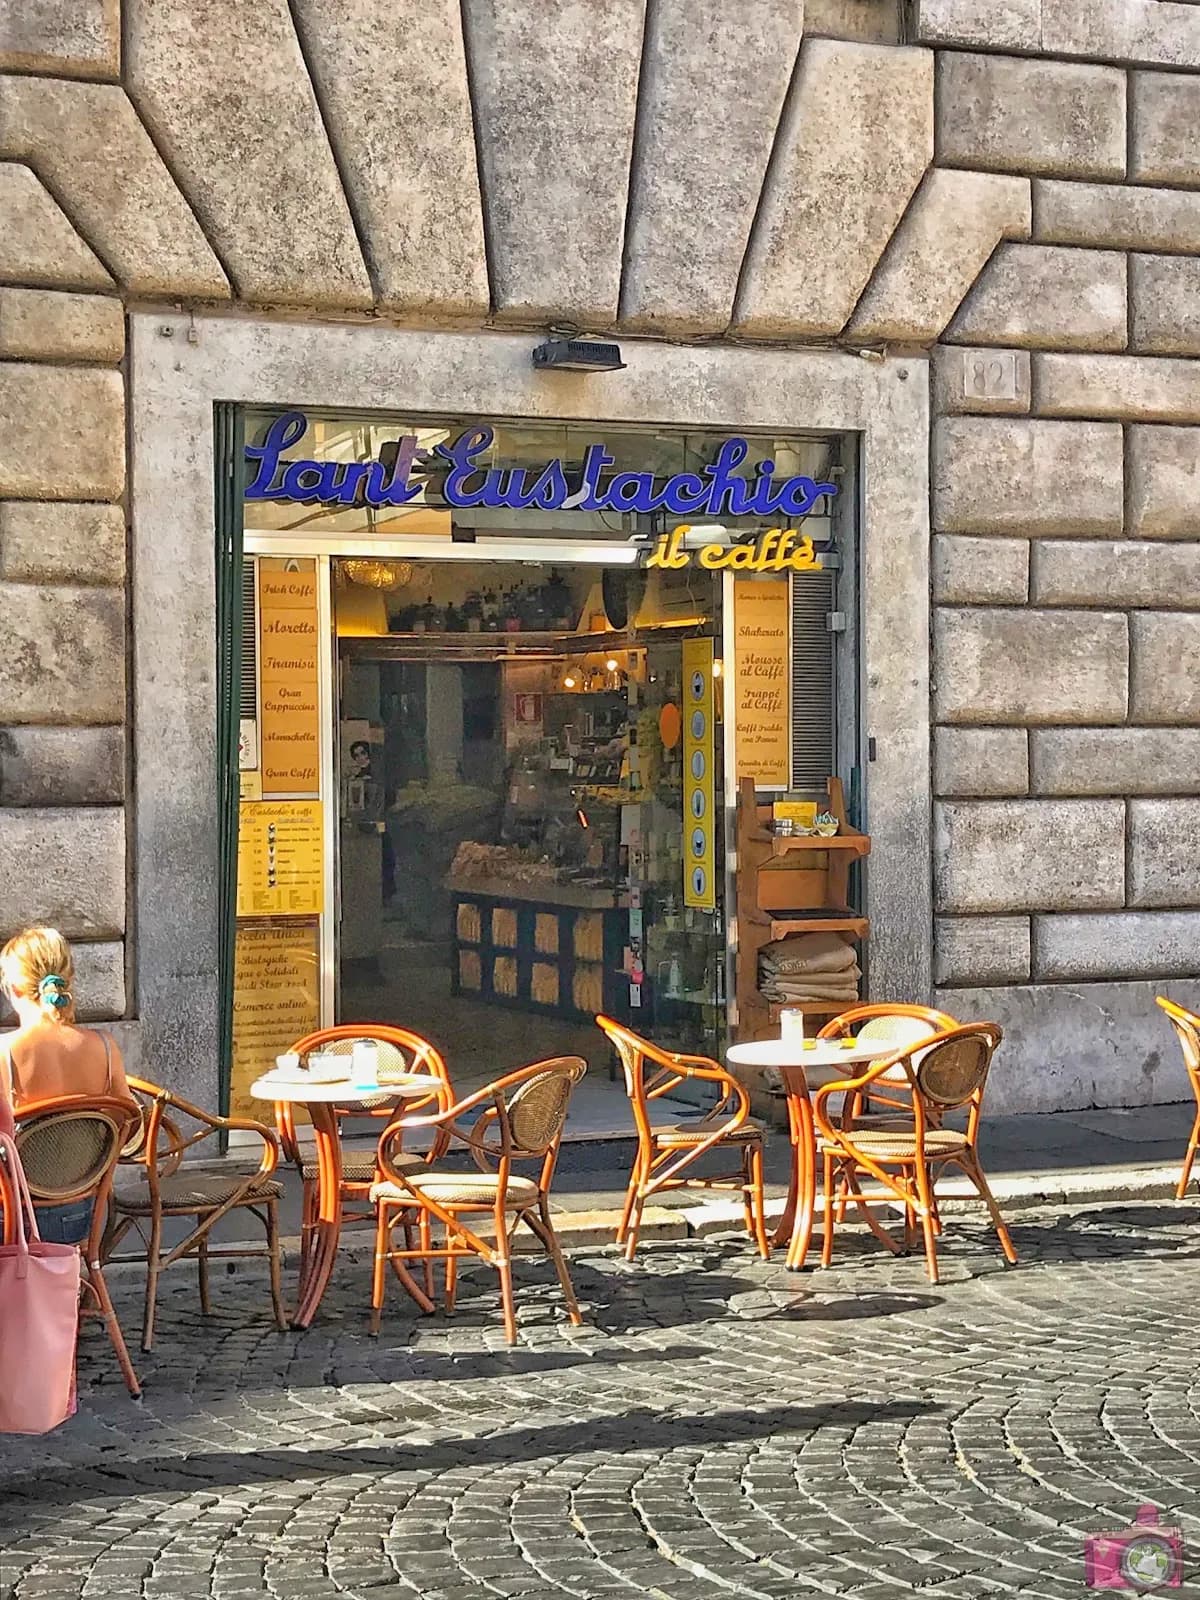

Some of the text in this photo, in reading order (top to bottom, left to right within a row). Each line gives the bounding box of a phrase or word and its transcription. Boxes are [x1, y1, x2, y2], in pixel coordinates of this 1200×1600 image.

[973, 360, 1006, 392] 82
[435, 424, 836, 516] Eustachio
[646, 525, 690, 569] il
[264, 619, 316, 633] Moretto
[741, 653, 783, 664] Mousse
[740, 665, 752, 676] al
[278, 687, 301, 698] Gran
[264, 701, 316, 713] Cappuccino
[741, 698, 753, 709] al
[265, 767, 289, 779] Gran
